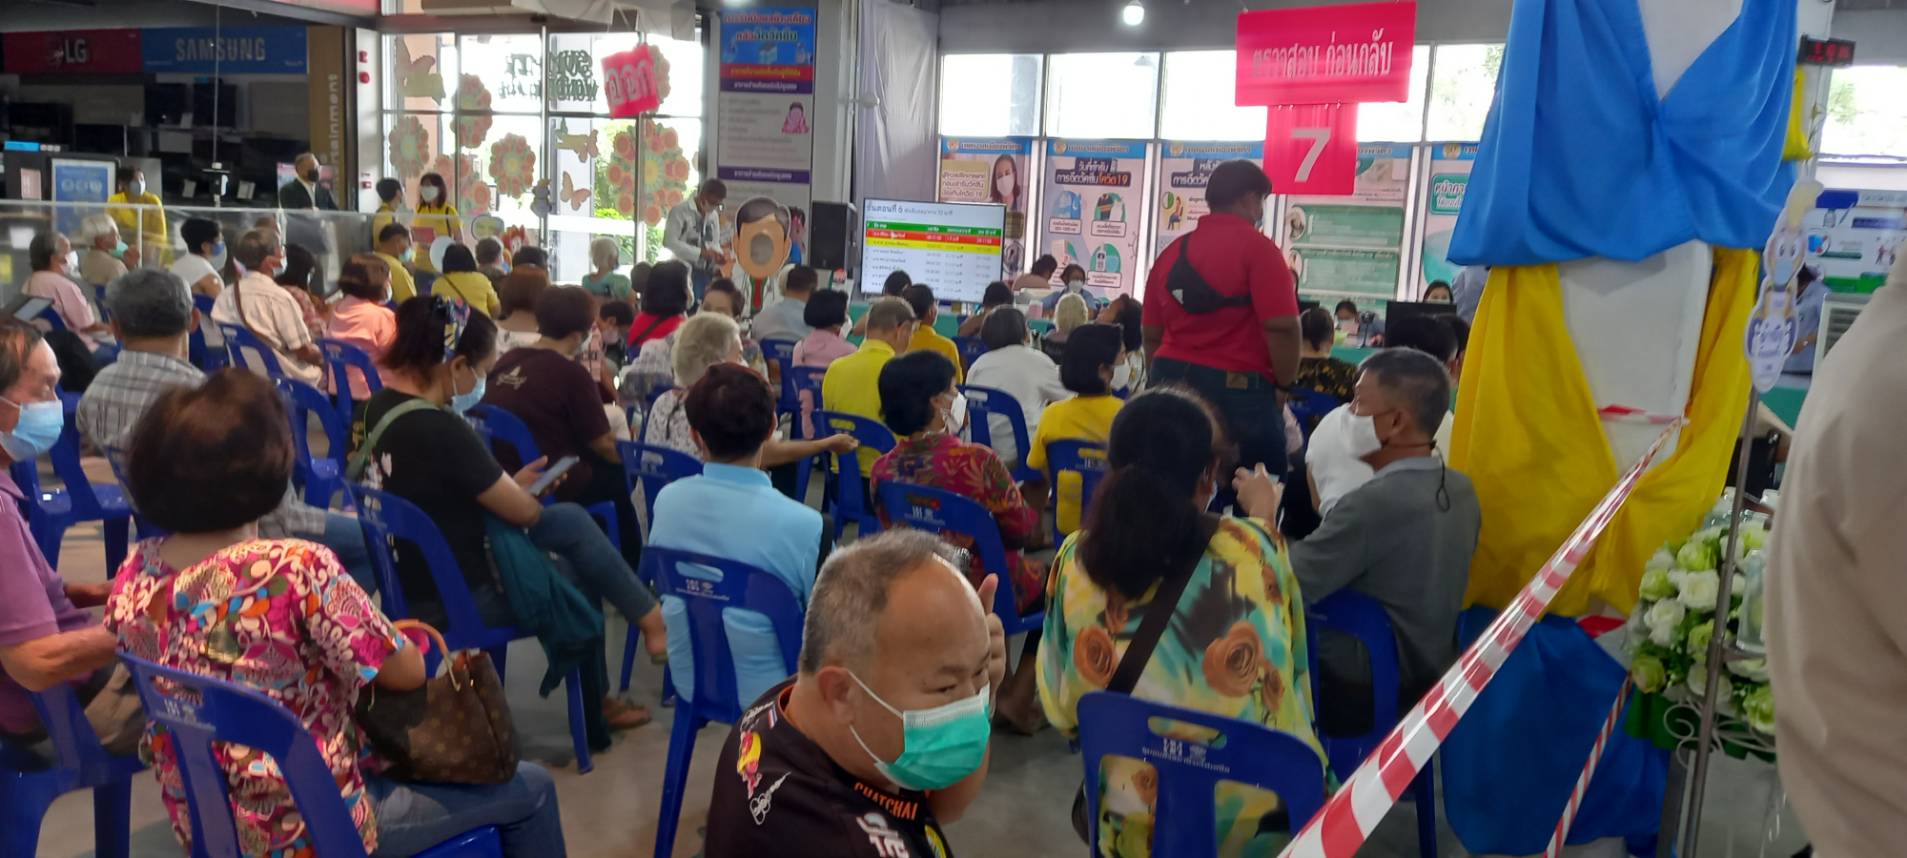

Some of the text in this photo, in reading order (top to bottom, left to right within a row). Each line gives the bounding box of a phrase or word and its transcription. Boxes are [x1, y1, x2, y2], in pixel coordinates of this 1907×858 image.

[65, 39, 88, 63] LG
[175, 37, 266, 62] SAMSUNG
[1290, 127, 1332, 184] 7
